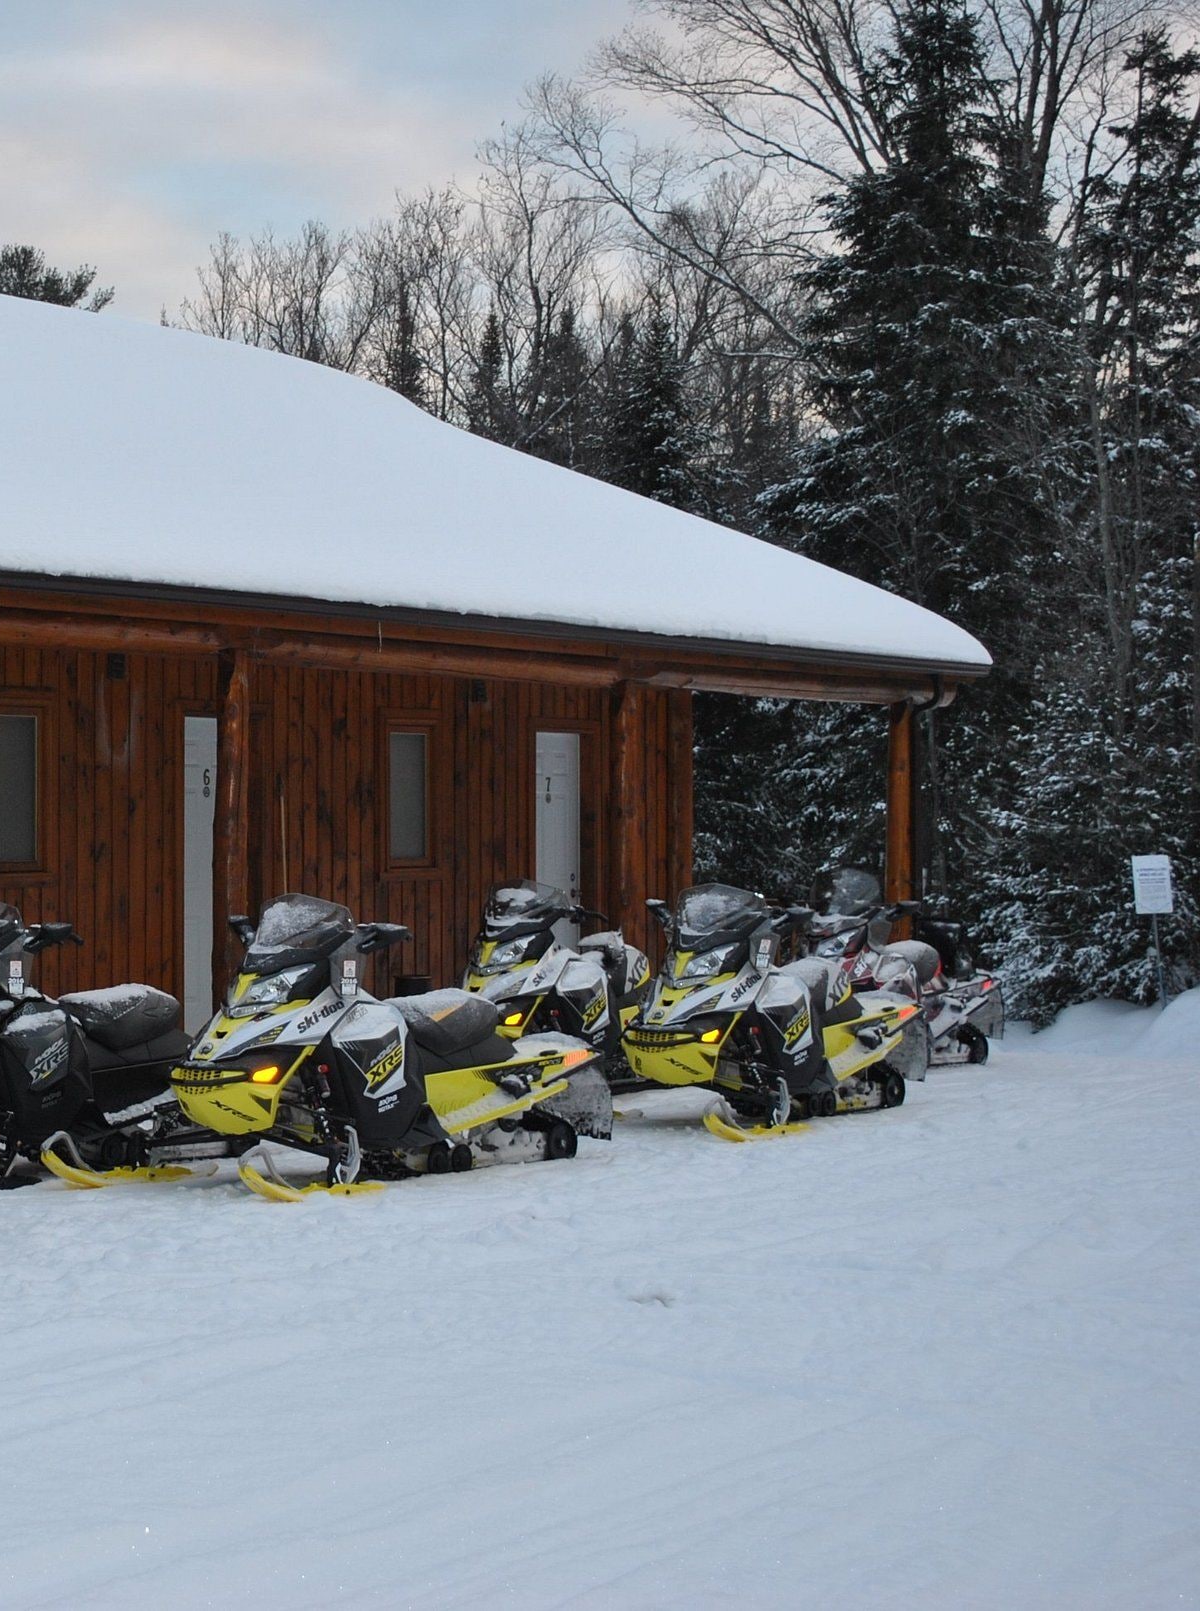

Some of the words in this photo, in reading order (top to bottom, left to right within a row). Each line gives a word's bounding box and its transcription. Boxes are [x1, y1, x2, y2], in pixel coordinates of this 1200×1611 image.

[204, 768, 210, 785] 6
[545, 776, 551, 792] 7
[297, 1001, 345, 1034] ski-doo
[368, 1045, 403, 1085] XRS
